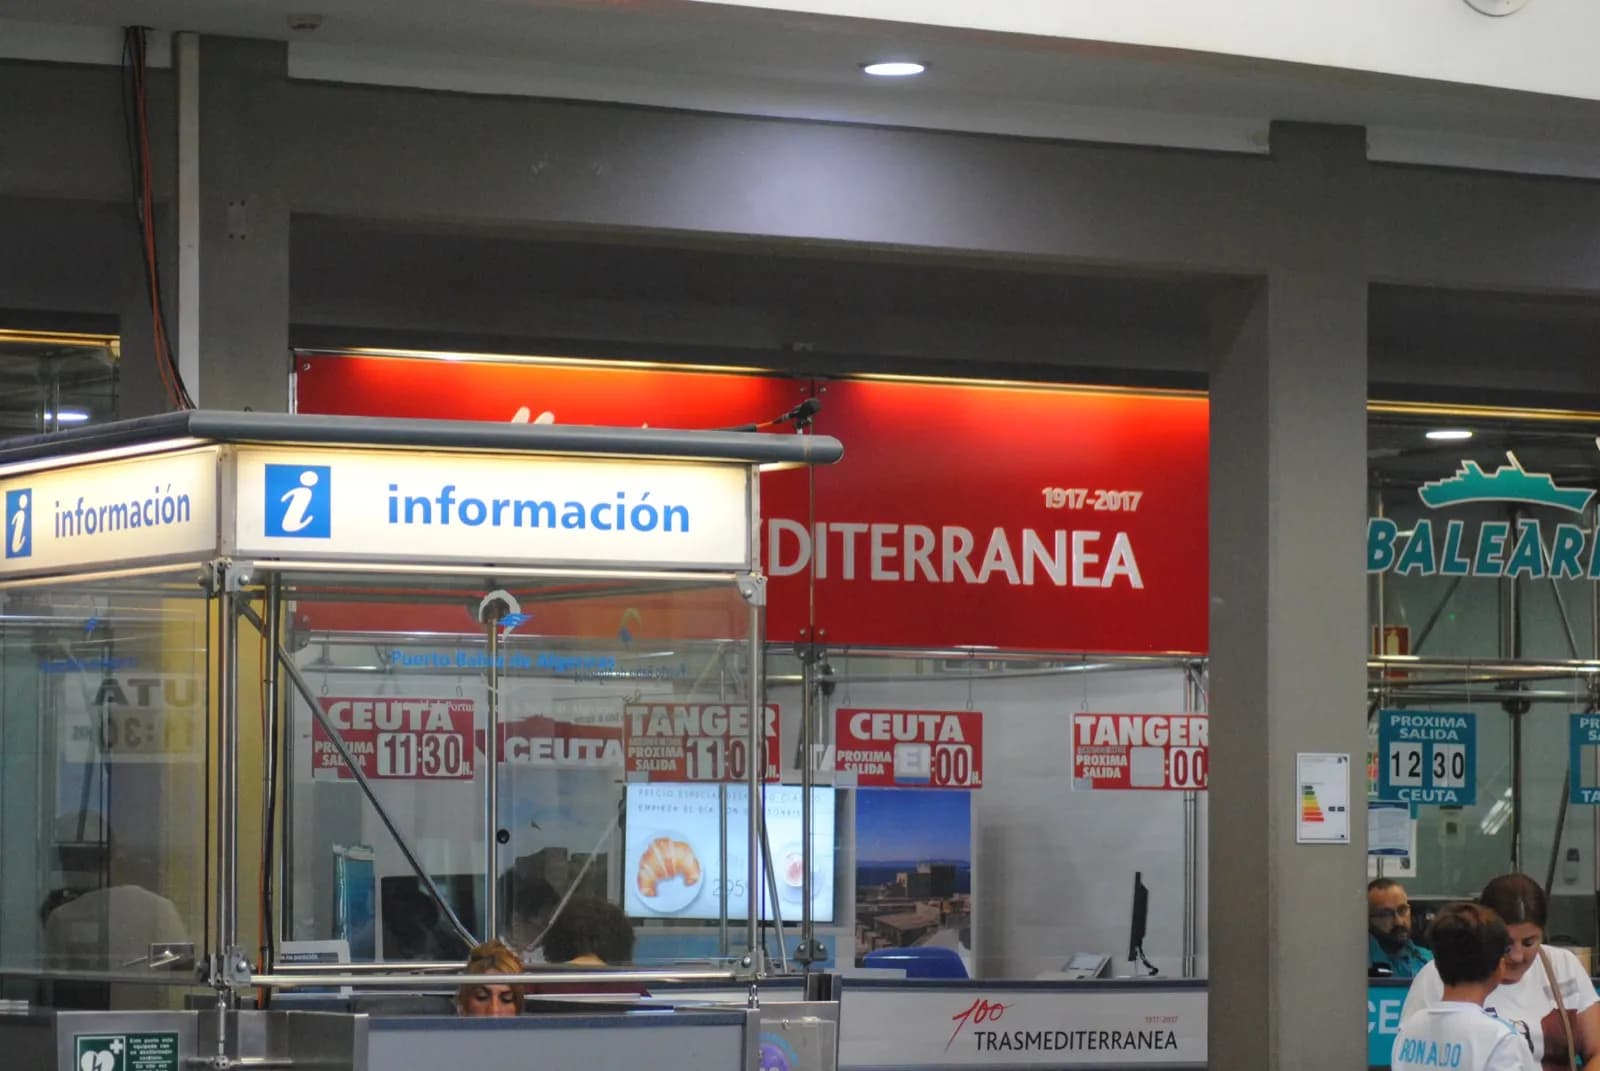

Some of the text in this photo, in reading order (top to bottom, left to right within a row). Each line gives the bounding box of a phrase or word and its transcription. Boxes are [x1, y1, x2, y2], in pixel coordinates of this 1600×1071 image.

[55, 484, 190, 538] información
[388, 484, 690, 533] información
[1041, 487, 1143, 512] 1917-2017
[758, 517, 1144, 590] DITERRANEA
[327, 701, 455, 731] CEUTA
[625, 704, 777, 738] TANGER
[849, 712, 966, 742] CEUTA
[1390, 715, 1468, 729] PROXIMA
[1074, 716, 1208, 747] TANGER
[1399, 728, 1459, 741] SALIDA
[384, 734, 462, 775] 11:30
[505, 736, 623, 767] CEUTA
[628, 746, 684, 758] PROXIMA
[837, 750, 892, 763] PROXIMA
[1076, 754, 1129, 767] PROXIMA
[635, 758, 677, 771] SALIDA
[843, 762, 885, 776] SALIDA
[1082, 766, 1121, 779] SALIDA
[1390, 751, 1465, 779] 12 30
[1397, 788, 1458, 803] CEUTA
[974, 1030, 1178, 1051] TRASMEDITERRANEA
